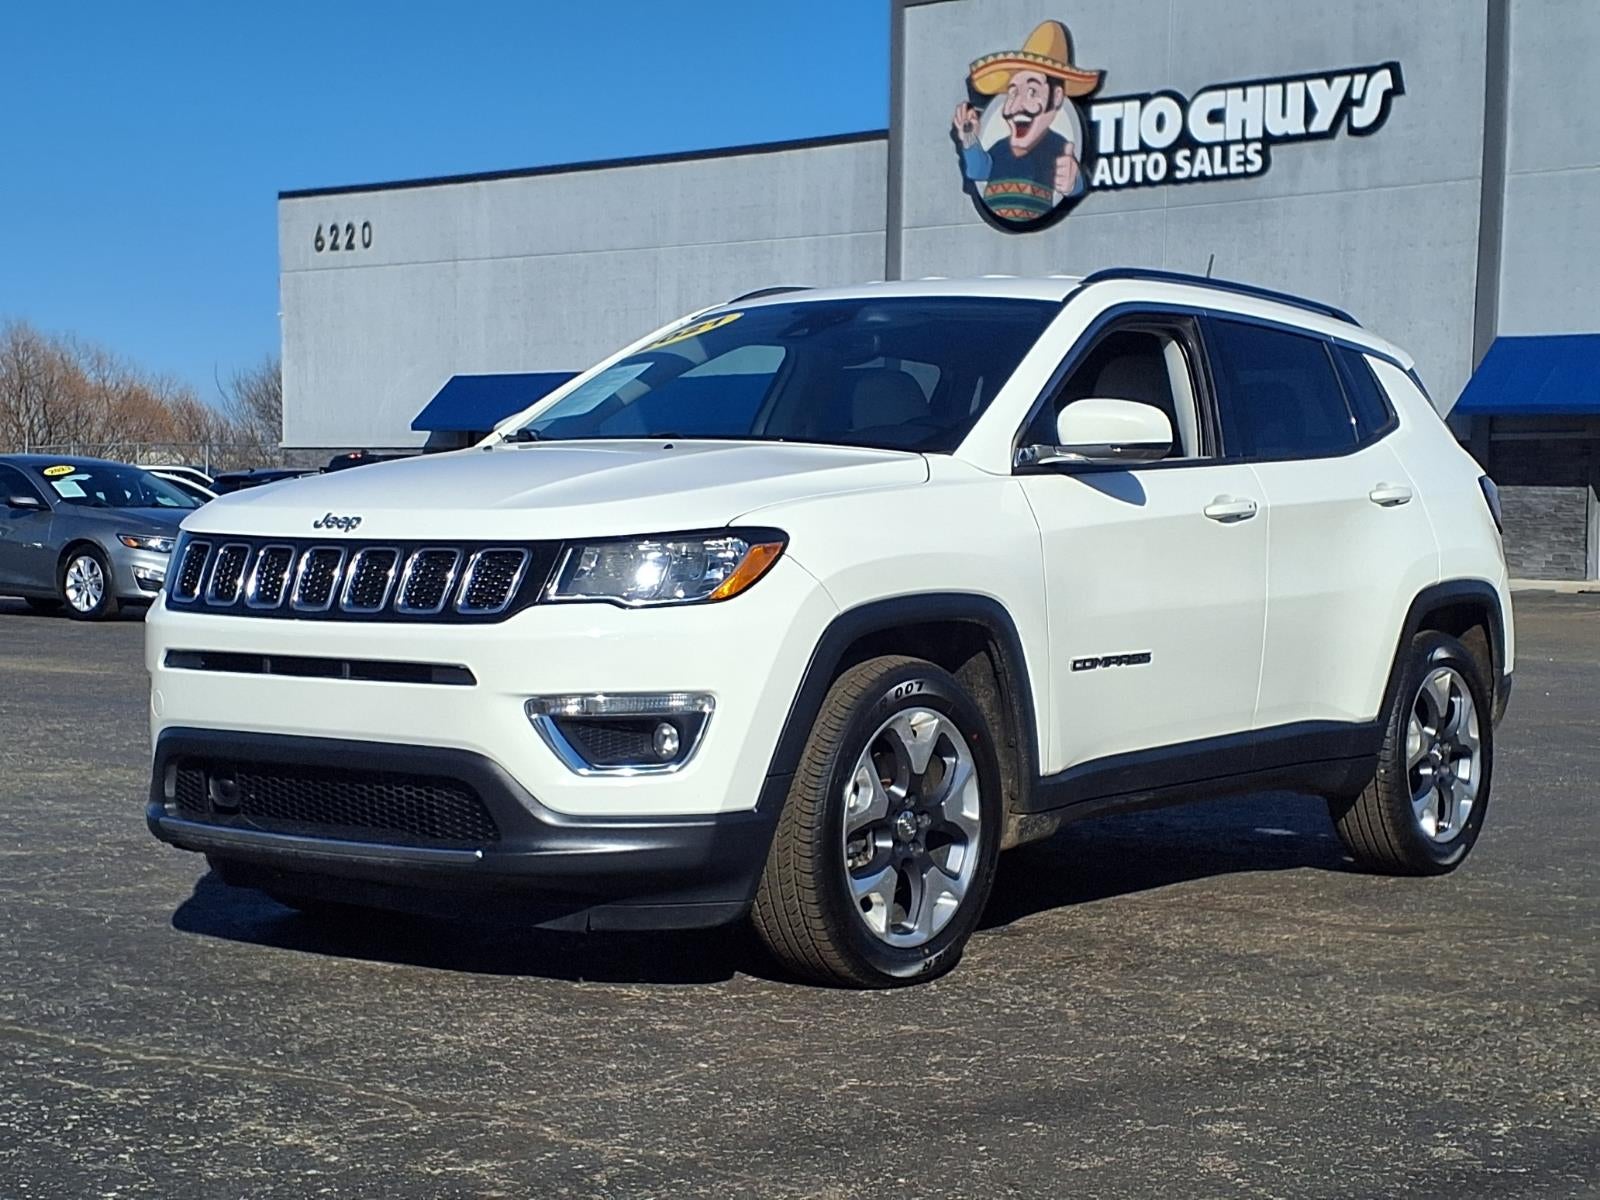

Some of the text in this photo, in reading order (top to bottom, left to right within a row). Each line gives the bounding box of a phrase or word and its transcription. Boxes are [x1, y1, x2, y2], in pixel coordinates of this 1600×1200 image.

[1091, 68, 1393, 153] TIO CHUY'S
[1092, 142, 1263, 186] AUTO SALES
[314, 221, 372, 253] 6220
[313, 512, 362, 533] Jeep
[1072, 652, 1151, 671] COMPASS
